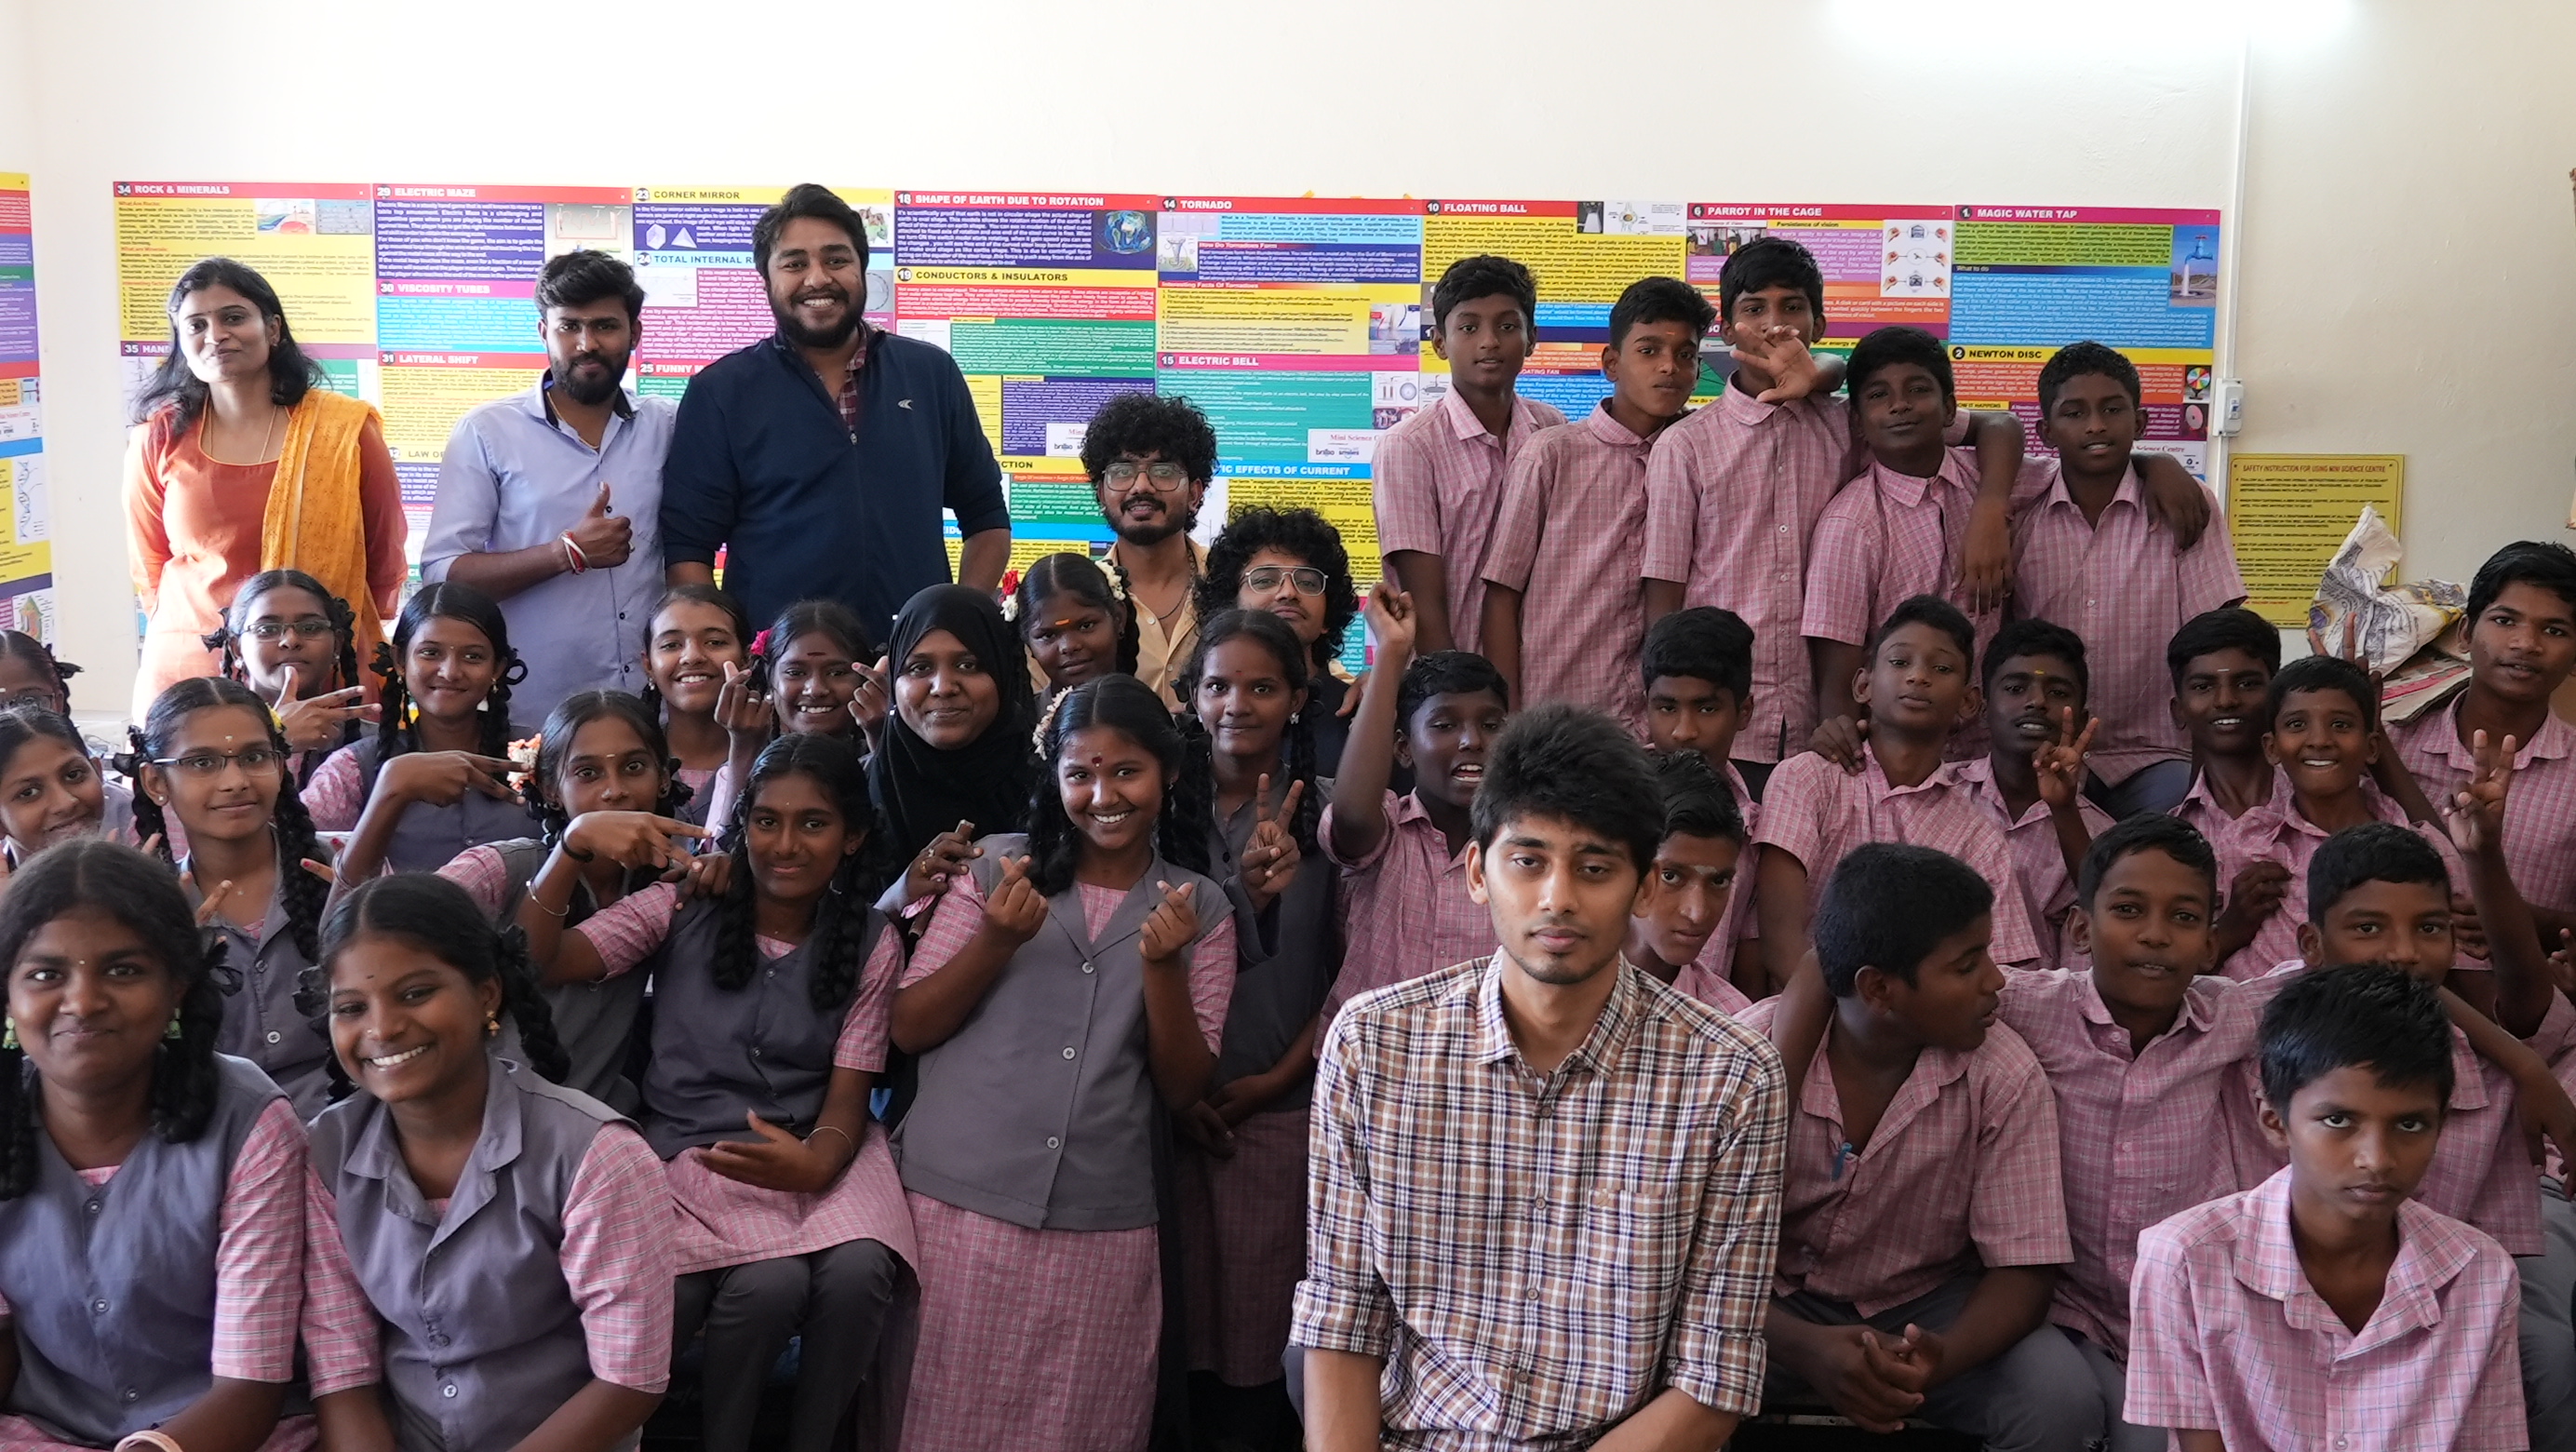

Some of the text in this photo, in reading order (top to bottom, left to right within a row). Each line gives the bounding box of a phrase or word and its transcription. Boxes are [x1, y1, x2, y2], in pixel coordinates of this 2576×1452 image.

[117, 184, 131, 195] 34
[134, 185, 164, 194] ROCK
[177, 185, 230, 195] MINERALS
[377, 187, 476, 197] 29 ELECTRIC MAZE
[636, 189, 650, 199] 23
[699, 191, 740, 199] MIRROR
[897, 194, 1104, 206] 18 SHAPE OF EARTH DUE TO ROTATION
[1163, 200, 1232, 209] 14 TORNADO
[1428, 203, 1527, 213] 10 FLOATING BALL
[1694, 207, 1821, 216] 6 PARROT IN THE CAGE
[1977, 208, 2013, 217] MAGIC
[2015, 209, 2053, 218] WATER
[2056, 210, 2078, 219] TAP
[637, 254, 651, 264] 24
[654, 255, 687, 263] TOTAL
[899, 270, 912, 279] 19
[916, 271, 987, 280] CONDUCTORS
[1002, 273, 1068, 281] INSULATORS
[381, 283, 490, 293] 30 VISCOSITY TUBES
[125, 344, 139, 354] 35
[1955, 349, 1963, 358] 2
[1969, 350, 2015, 358] NEWTON
[382, 354, 478, 364] 31 LATERAL SHIFT
[1161, 356, 1259, 366] 15 ELECTRIC BELL
[640, 364, 654, 373] 25
[655, 364, 692, 372] FUNNY
[1000, 461, 1033, 469] CTION
[1235, 465, 1281, 475] EFFECTS
[1283, 465, 1297, 475] OF
[1300, 465, 1350, 476] CURRENT
